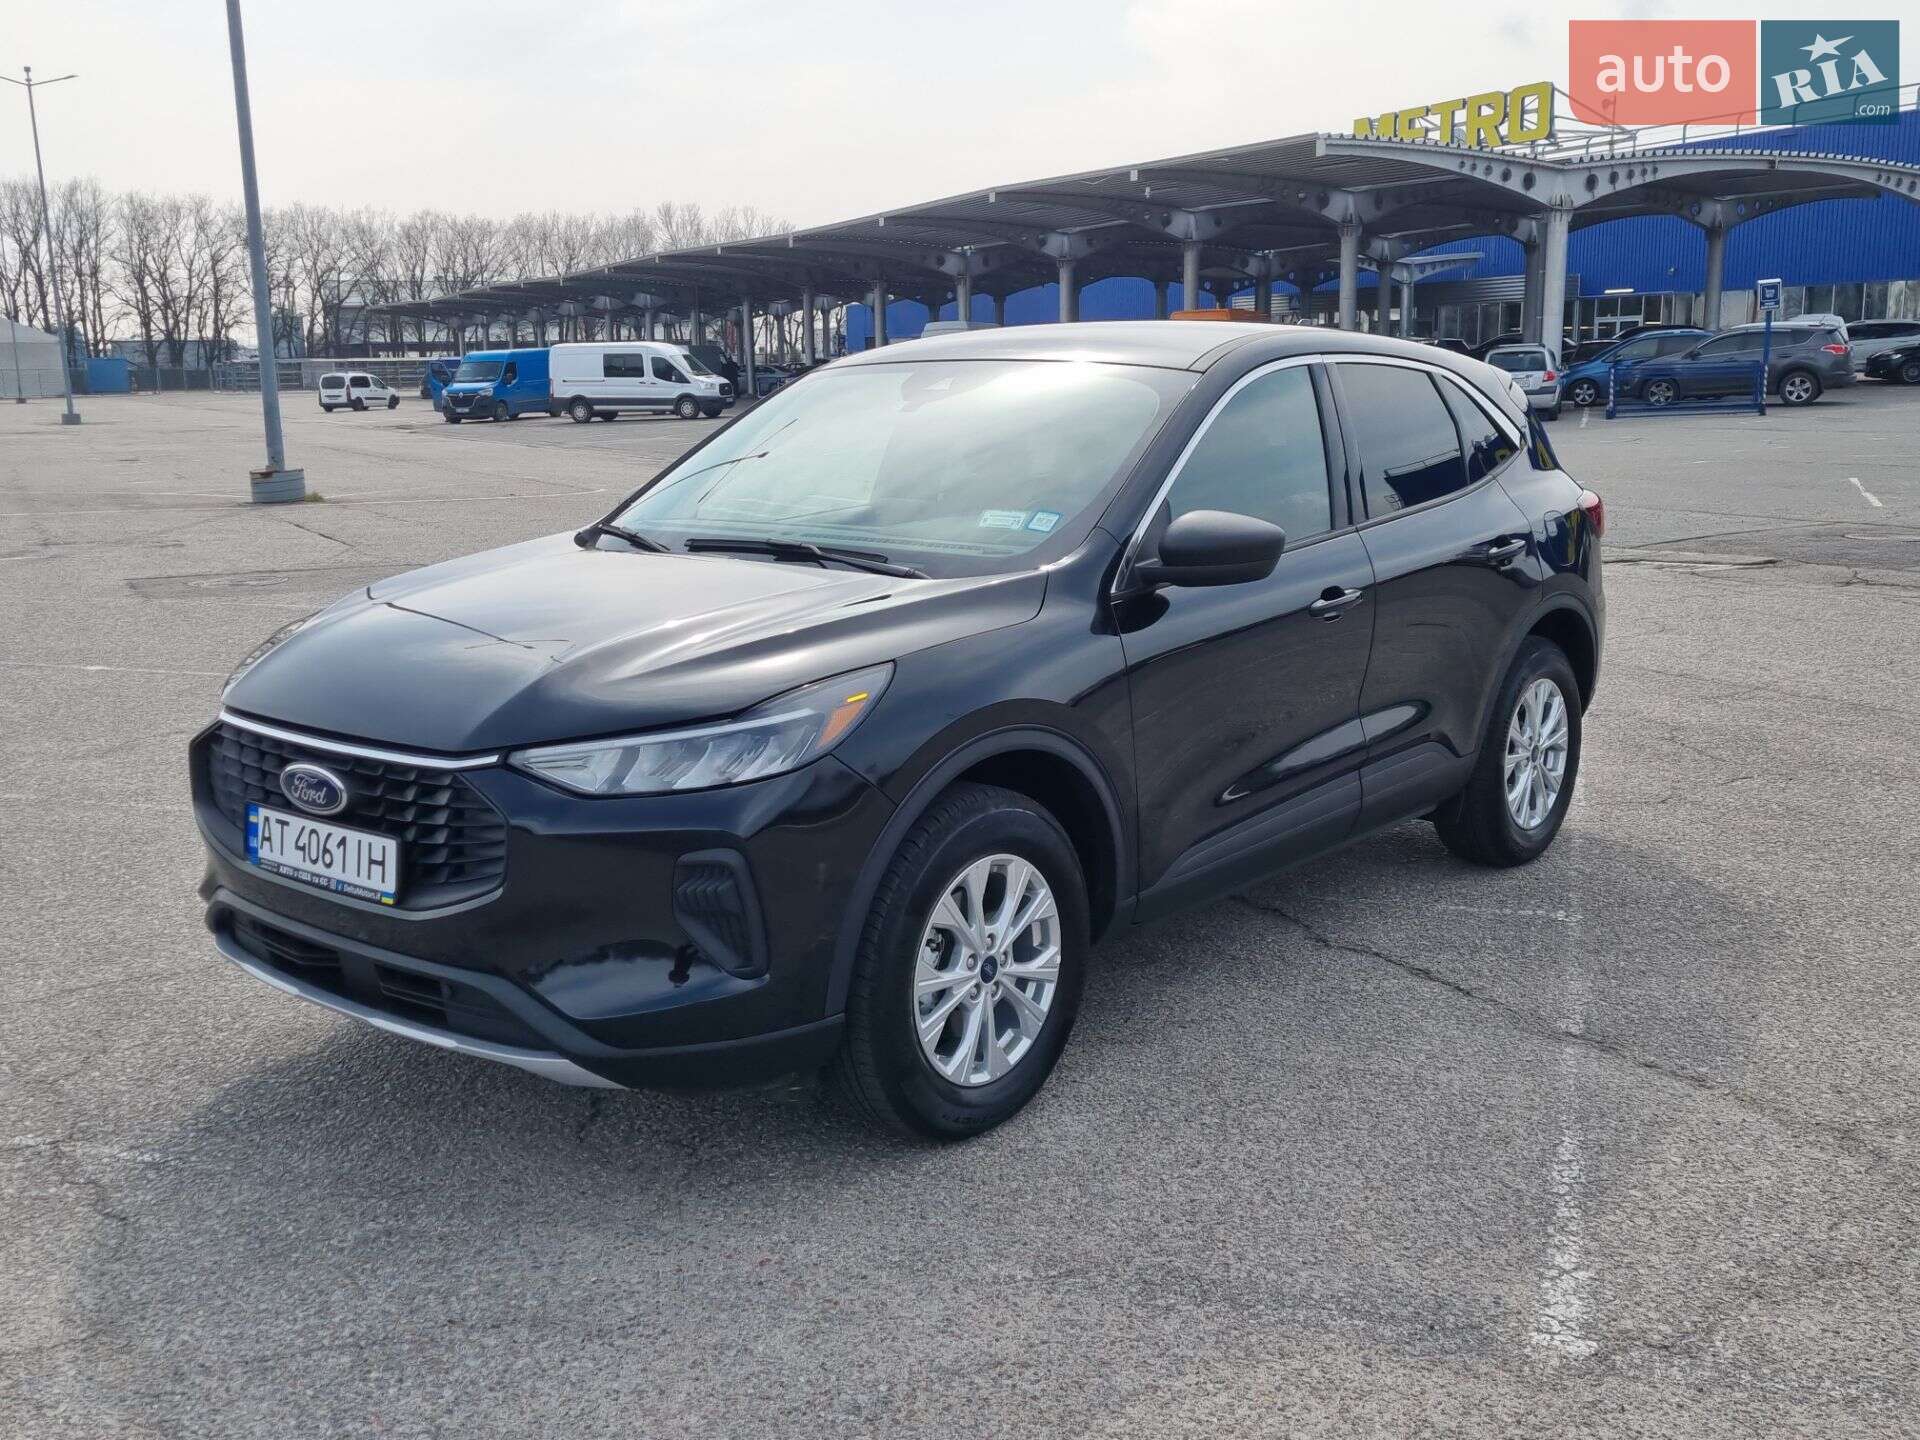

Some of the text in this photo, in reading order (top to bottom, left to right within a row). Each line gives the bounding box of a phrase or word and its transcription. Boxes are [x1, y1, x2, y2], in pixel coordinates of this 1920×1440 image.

[1353, 81, 1555, 148] METRO
[291, 773, 328, 805] Ford
[260, 815, 386, 884] AT 4061 IH
